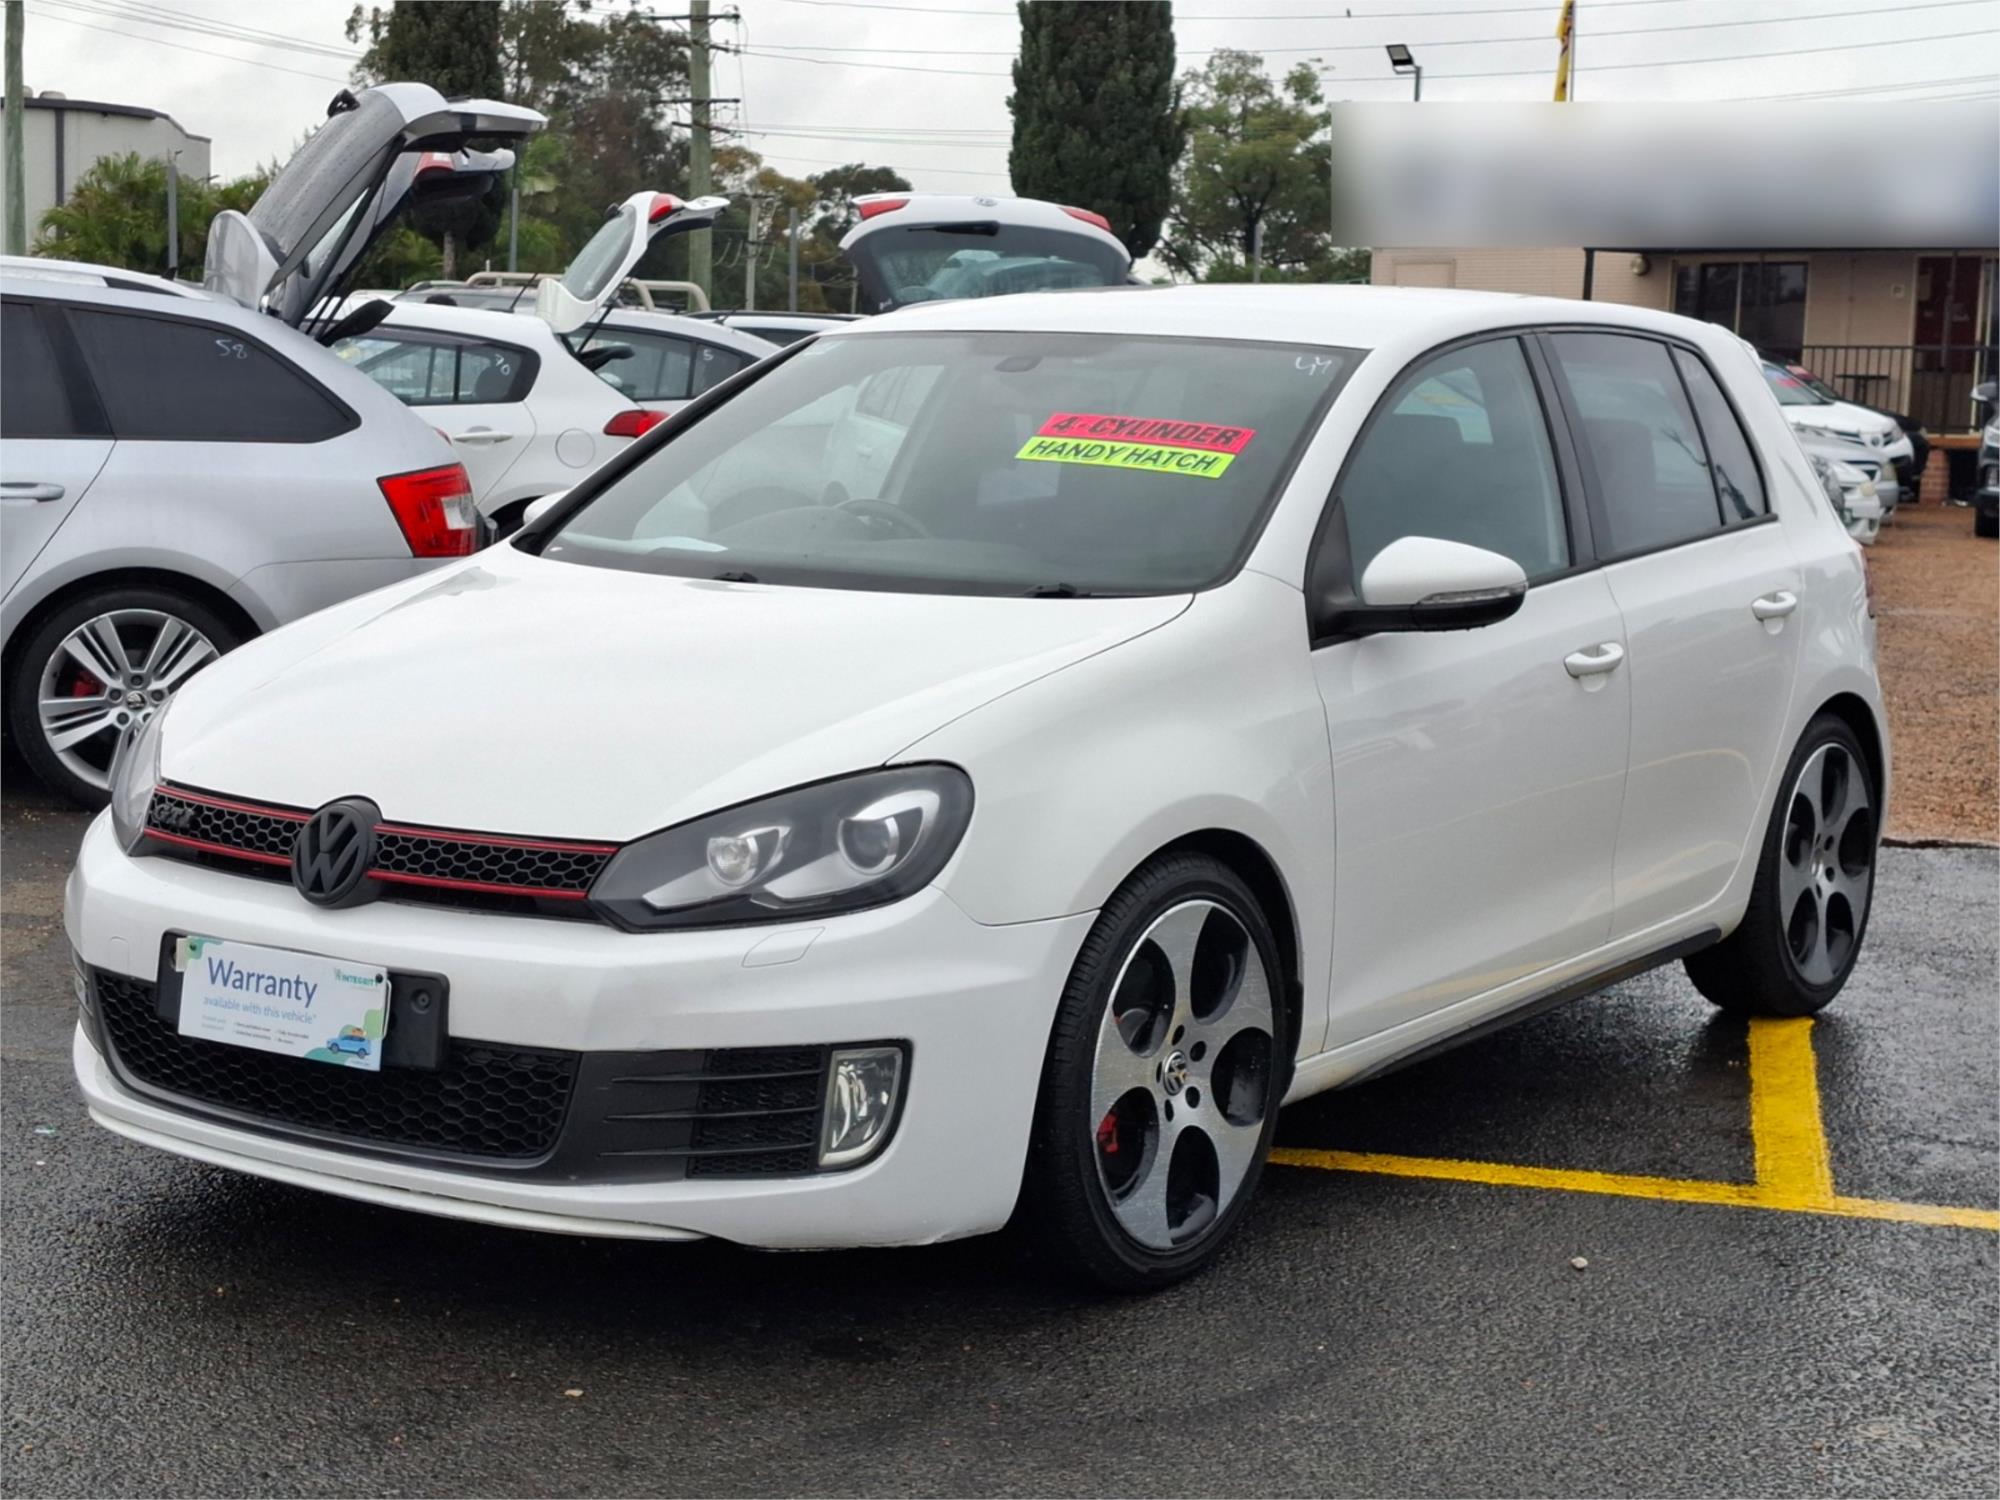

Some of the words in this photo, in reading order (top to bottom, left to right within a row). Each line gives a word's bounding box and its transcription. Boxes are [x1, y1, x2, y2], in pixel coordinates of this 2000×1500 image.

[215, 339, 248, 360] 58
[495, 353, 511, 376] 70
[1052, 416, 1242, 446] 4-CYLINDER
[1029, 440, 1125, 461] HANDY
[1122, 447, 1220, 471] HATCH
[208, 956, 317, 1008] Warranty
[203, 997, 240, 1010] available
[243, 1002, 261, 1015] with
[264, 1006, 280, 1018] this
